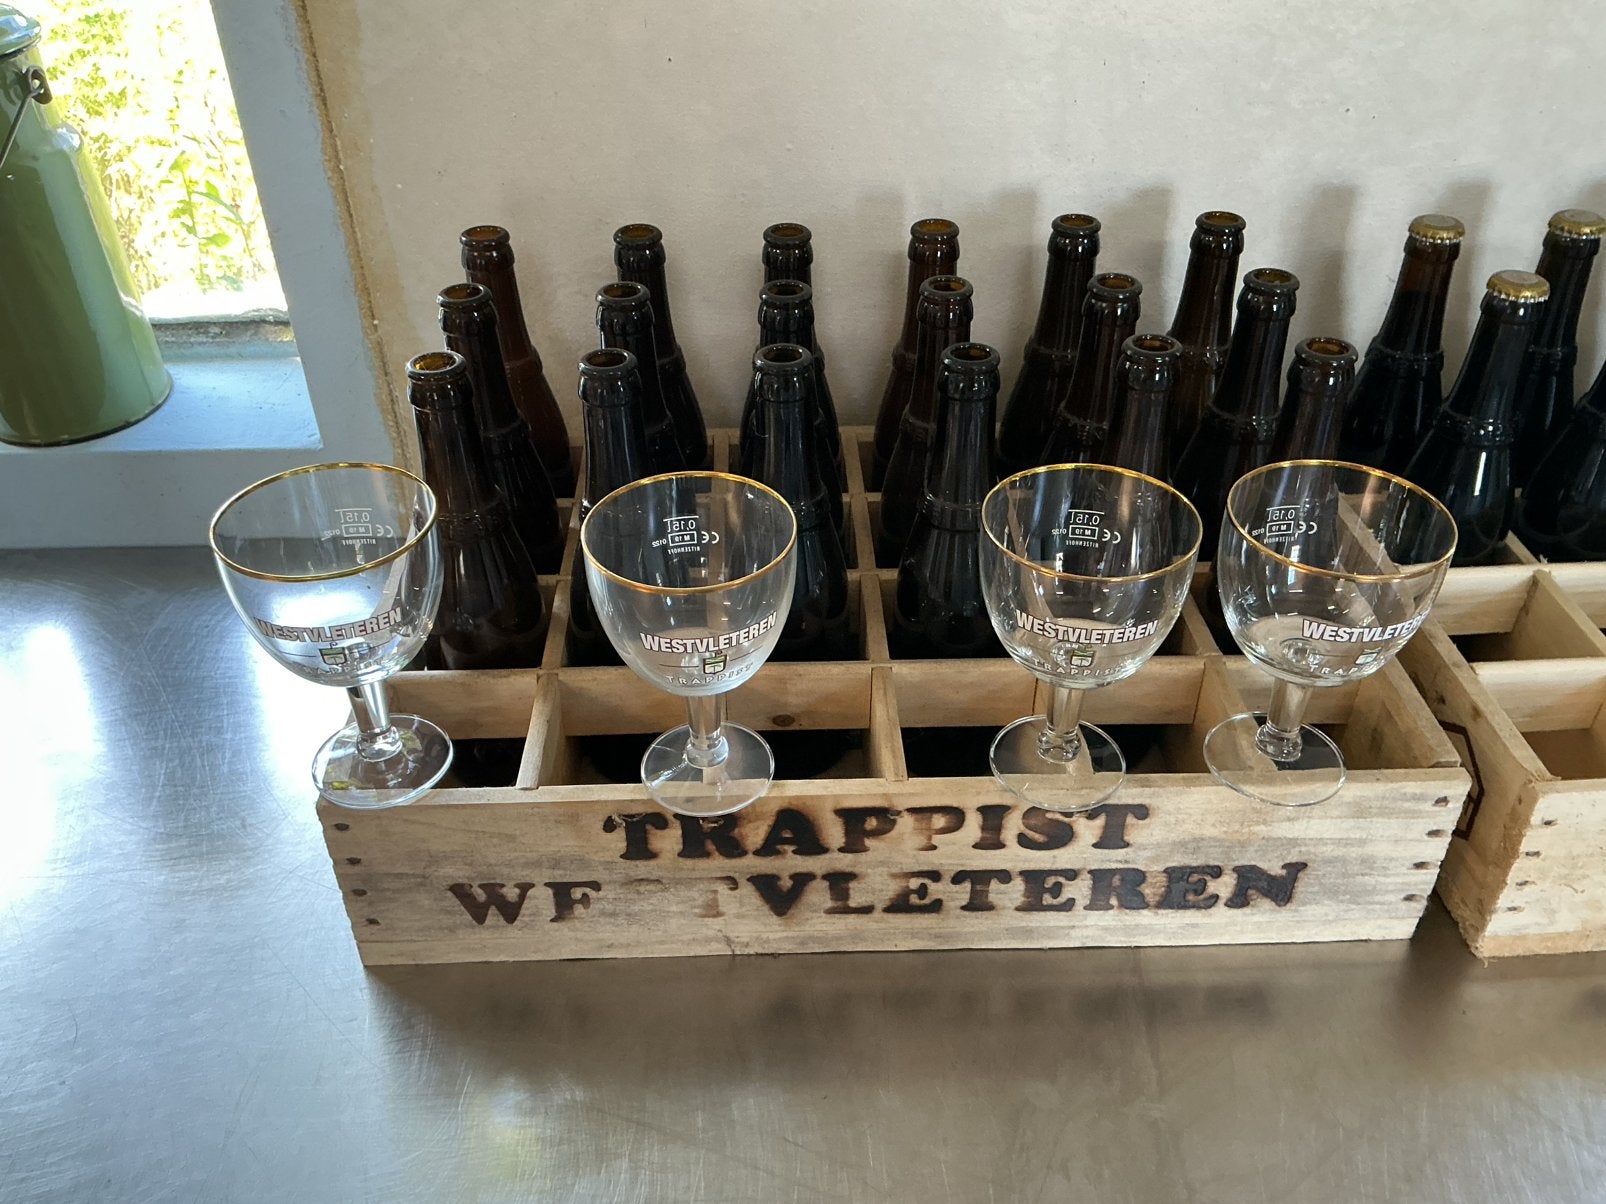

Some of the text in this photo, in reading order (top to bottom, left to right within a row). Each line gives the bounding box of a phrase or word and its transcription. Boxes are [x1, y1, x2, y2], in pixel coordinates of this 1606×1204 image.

[254, 607, 401, 642] WESTVLETEREN
[640, 611, 777, 653] WESTVLETEREN
[1016, 609, 1159, 644] WESTVLETEREN
[602, 803, 1149, 860] TRAPPIST
